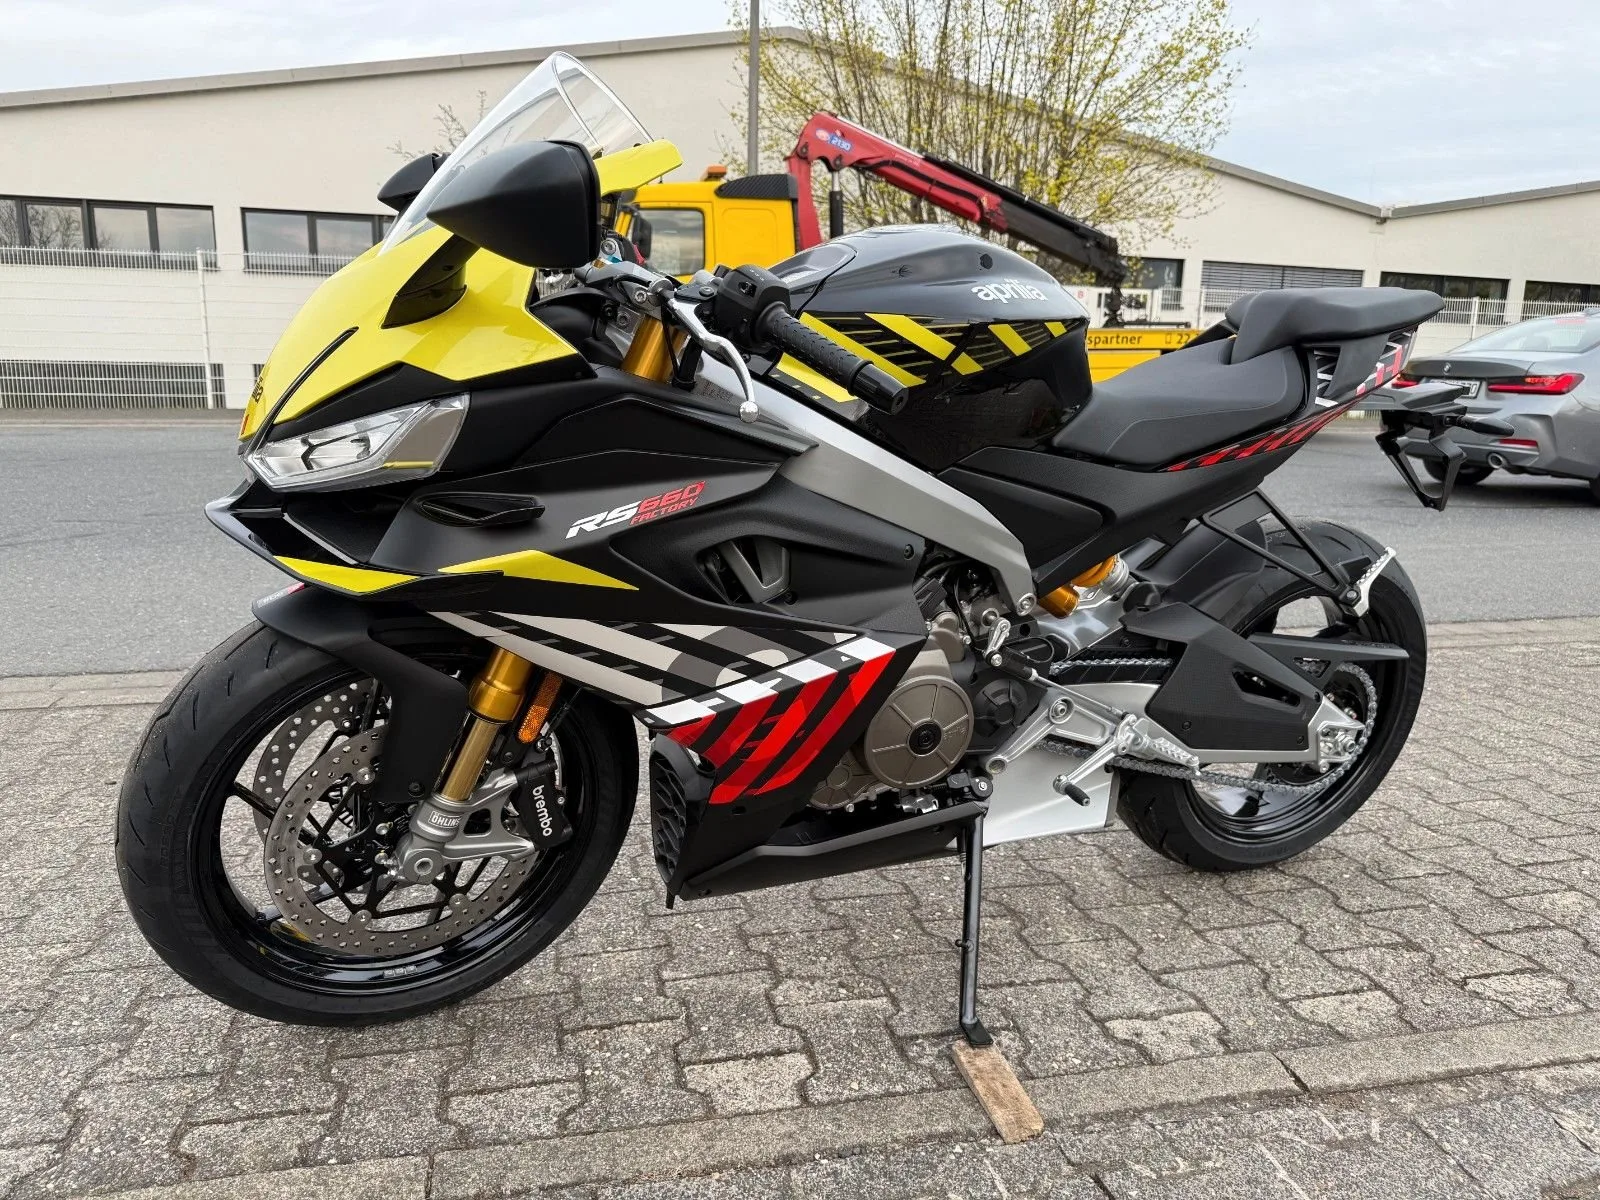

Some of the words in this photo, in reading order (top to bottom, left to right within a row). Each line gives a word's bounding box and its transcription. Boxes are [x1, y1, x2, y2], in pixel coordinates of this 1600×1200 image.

[971, 278, 1048, 303] aprilia
[1087, 333, 1142, 346] spartner
[630, 497, 699, 526] FACTORY
[533, 784, 553, 837] brembo
